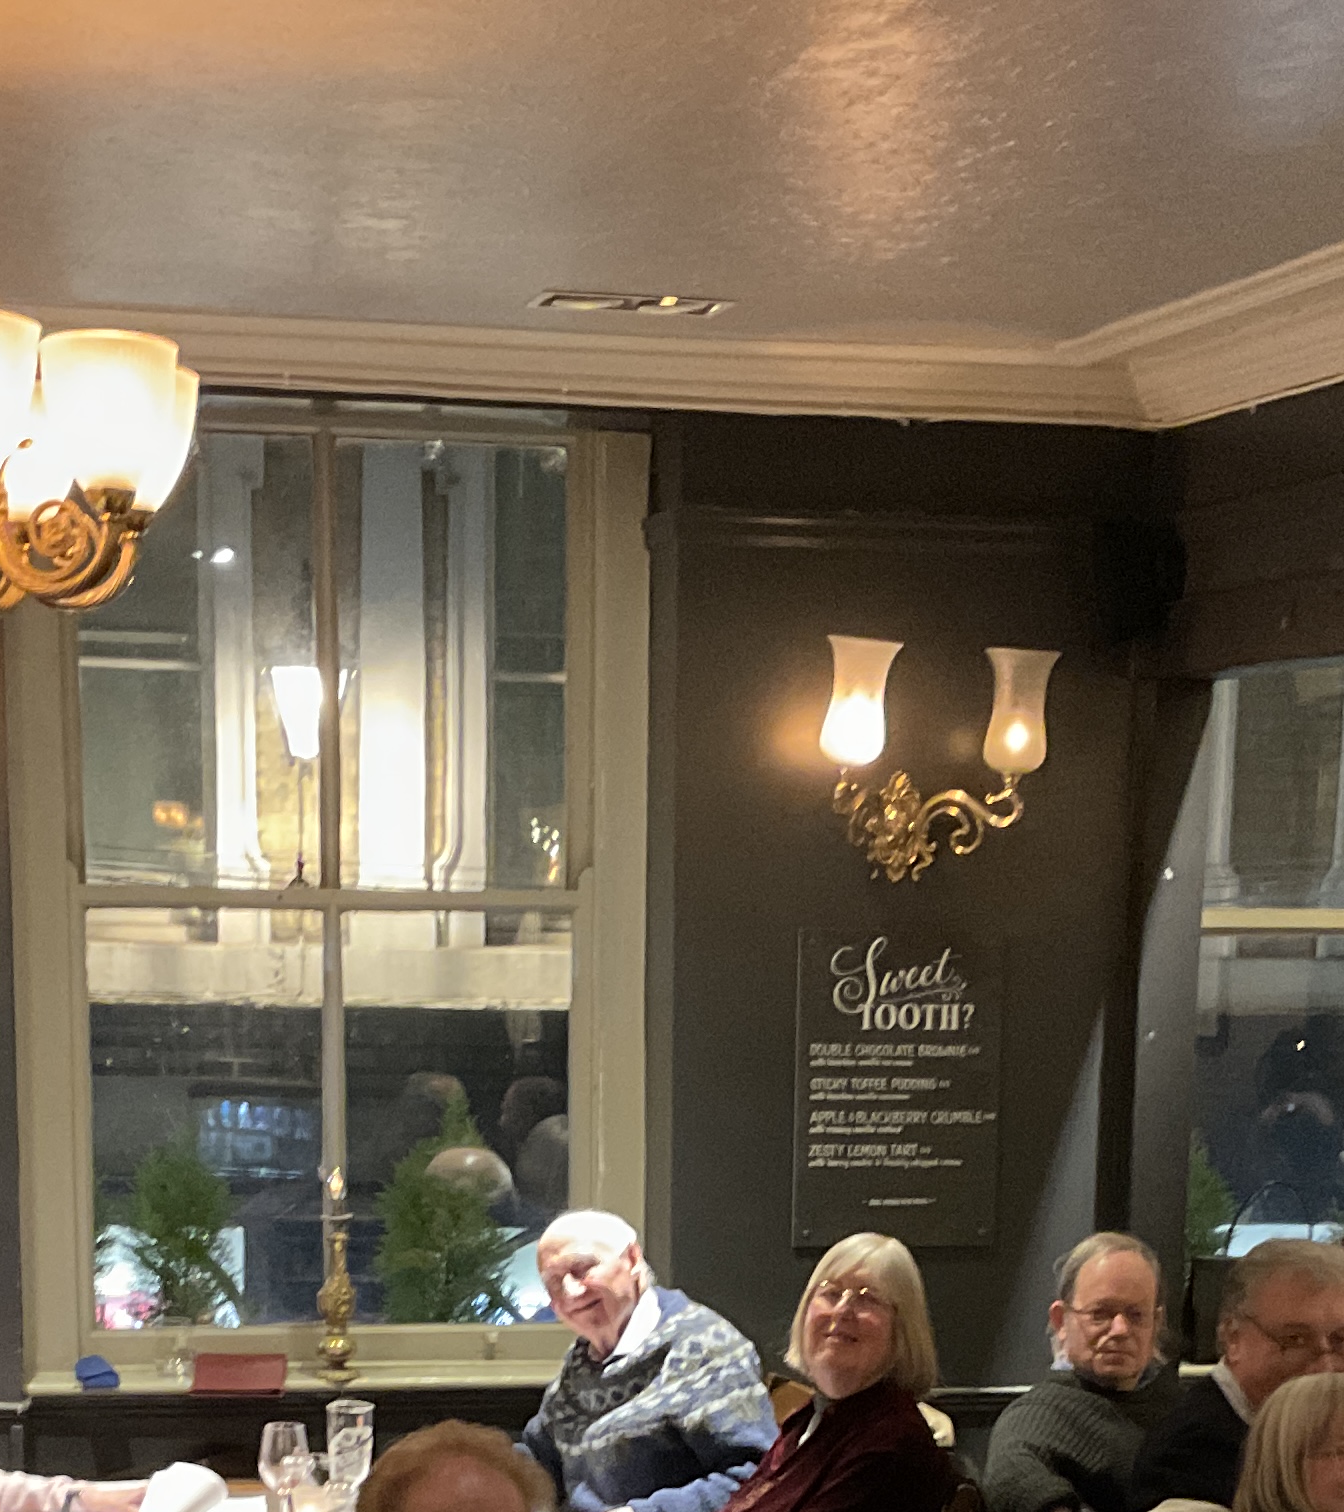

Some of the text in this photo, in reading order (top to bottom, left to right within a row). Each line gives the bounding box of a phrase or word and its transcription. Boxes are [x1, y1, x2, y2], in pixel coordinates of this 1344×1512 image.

[830, 936, 963, 1014] Sweet
[859, 1002, 975, 1031] TOOTH?
[809, 1043, 853, 1057] DOUBLE
[855, 1043, 915, 1057] CHOCOLATE
[918, 1044, 968, 1058] BROWNIE
[809, 1077, 848, 1091] STICKY
[851, 1077, 888, 1091] TOFFEE
[891, 1077, 937, 1091] PUDDING
[809, 1110, 845, 1124] APPLE
[856, 1110, 928, 1125] BLACKBERRY
[930, 1111, 983, 1125] CRUMBLE
[808, 1143, 919, 1157] ZESTY LEMON TART
